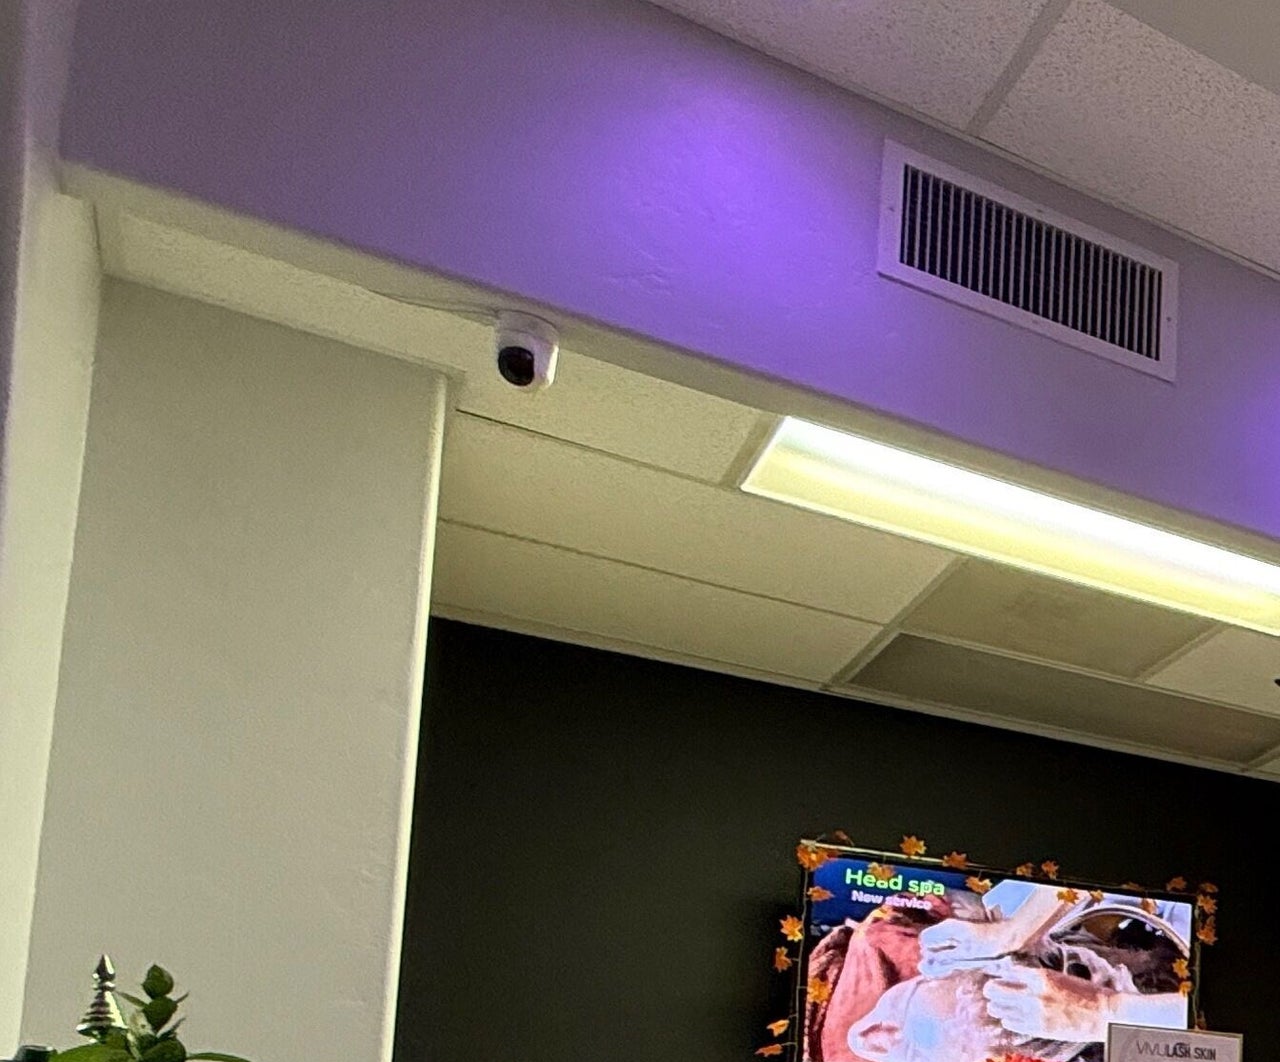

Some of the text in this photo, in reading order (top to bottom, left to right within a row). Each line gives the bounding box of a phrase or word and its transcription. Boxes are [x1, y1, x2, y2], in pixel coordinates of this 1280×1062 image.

[908, 879, 945, 896] spa
[851, 890, 883, 904] New
[1193, 1047, 1217, 1061] SKIN
